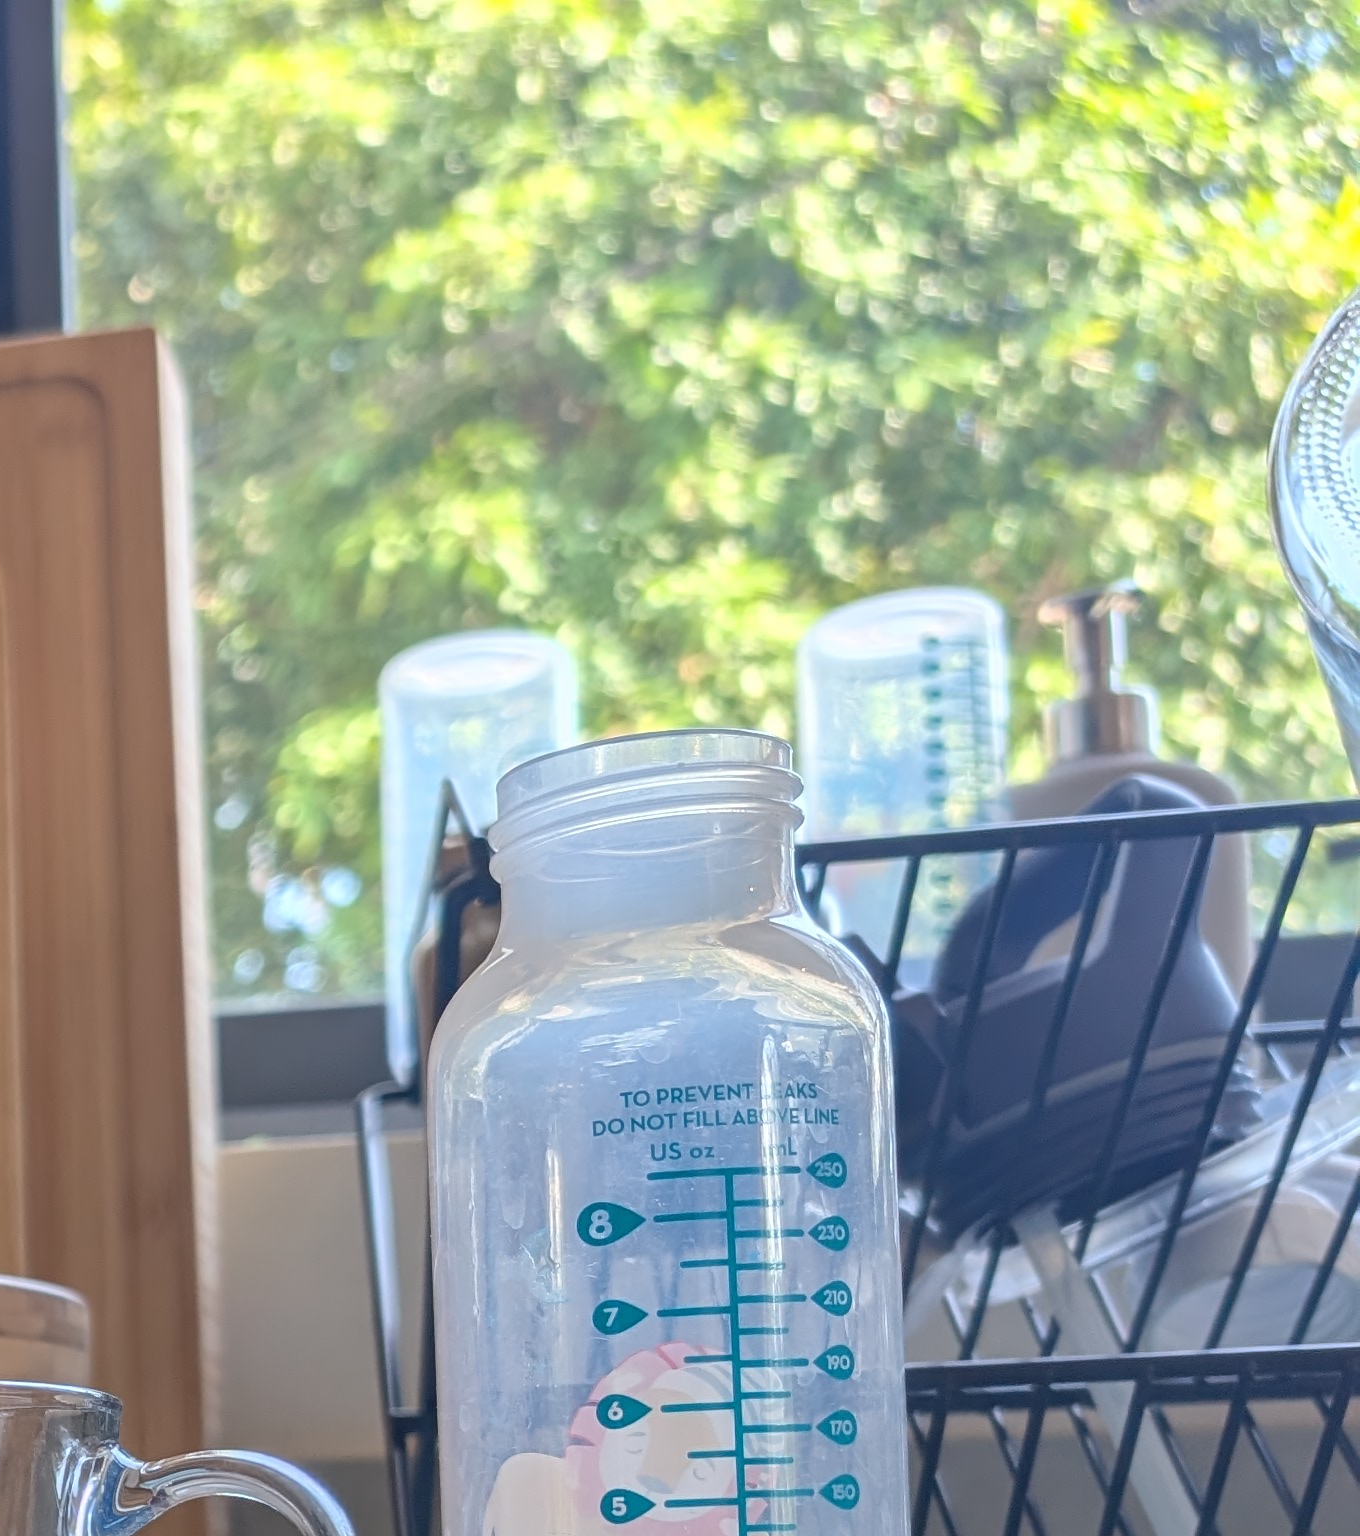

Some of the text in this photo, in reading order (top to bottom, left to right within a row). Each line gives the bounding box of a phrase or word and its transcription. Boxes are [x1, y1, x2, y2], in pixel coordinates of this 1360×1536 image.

[620, 1089, 650, 1108] TO
[657, 1083, 753, 1105] PREVENT
[592, 1107, 839, 1137] DO NOT FILL ABOVE LINE
[650, 1142, 715, 1161] US oz
[814, 1160, 843, 1178] 250
[587, 1208, 613, 1240] 8
[817, 1224, 846, 1242] 230
[823, 1289, 848, 1306] 210
[602, 1306, 620, 1328] 7
[826, 1354, 850, 1370] 190
[607, 1401, 624, 1421] 6
[830, 1420, 853, 1436] 170
[831, 1484, 856, 1500] 150
[611, 1497, 627, 1517] 5
